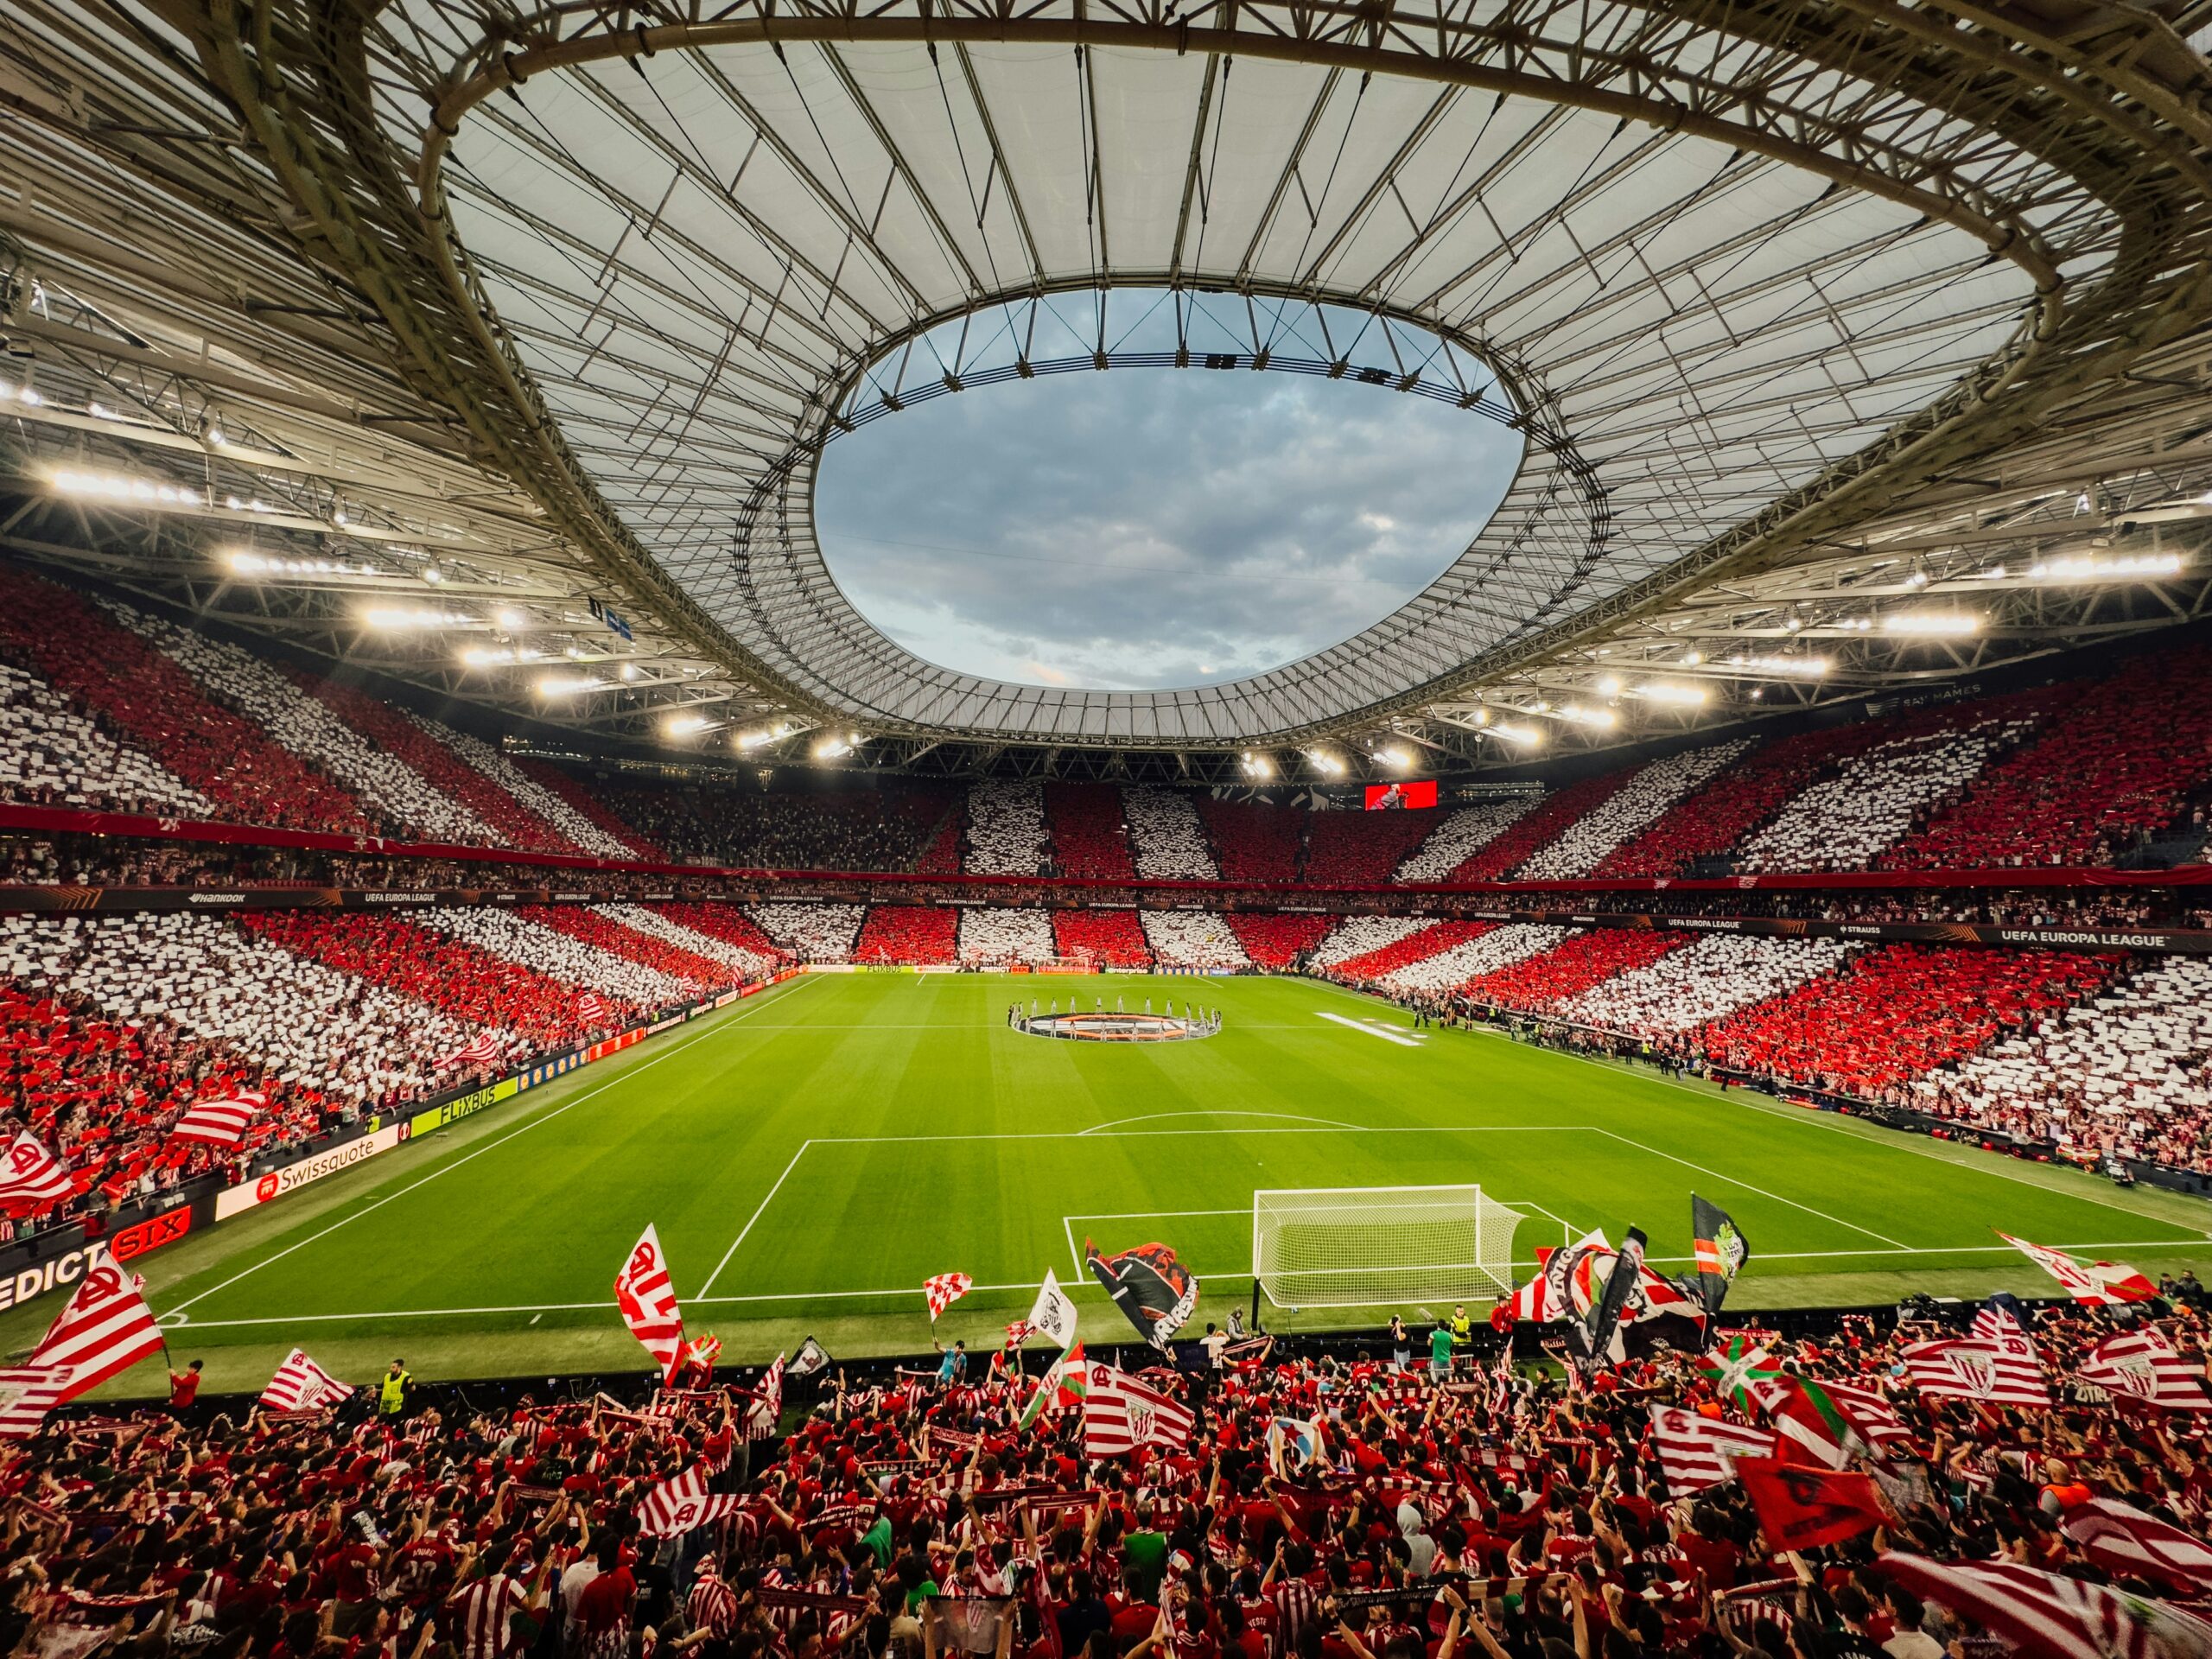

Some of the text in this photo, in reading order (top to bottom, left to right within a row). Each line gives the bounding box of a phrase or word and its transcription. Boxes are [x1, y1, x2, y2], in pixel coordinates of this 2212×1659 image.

[365, 893, 435, 902] UEFA EUROPA LEAGUE
[1713, 920, 1739, 929] LEAGUE
[2001, 931, 2165, 947] UEFA EUROPA LEAGUE
[281, 1140, 374, 1191] Swissquote
[118, 1211, 185, 1257] SIX
[1247, 1617, 1268, 1627] YESTE
